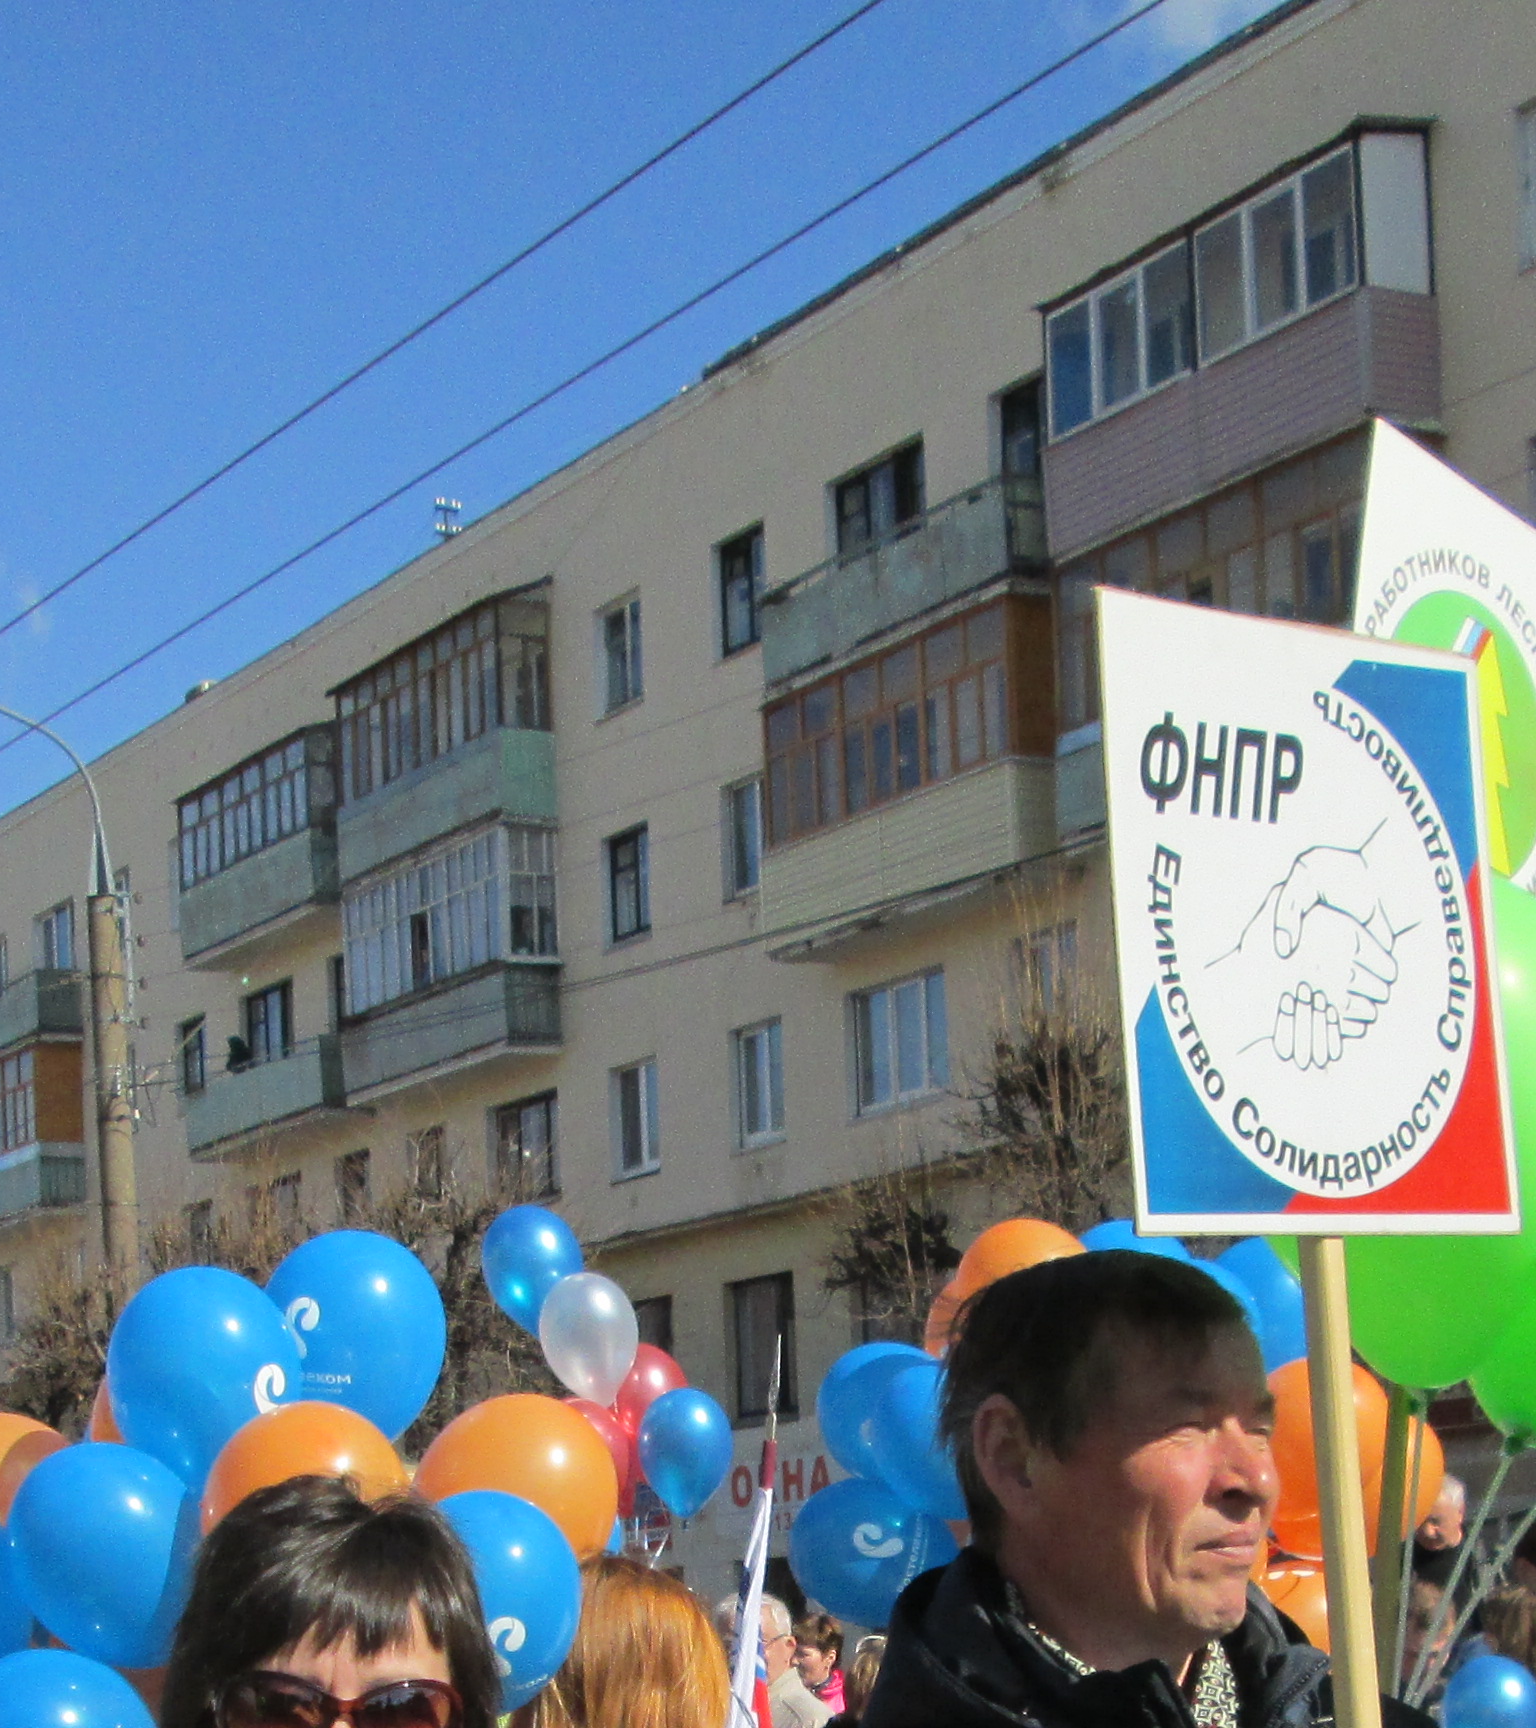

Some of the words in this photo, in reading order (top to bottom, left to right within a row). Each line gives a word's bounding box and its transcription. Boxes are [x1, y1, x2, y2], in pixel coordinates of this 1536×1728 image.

[1139, 710, 1304, 825] ФНПР
[1313, 690, 1474, 1053] Справедливость
[1148, 842, 1225, 1102] Единство
[1231, 1068, 1452, 1190] Солидарность
[731, 1455, 831, 1508] ОНА
